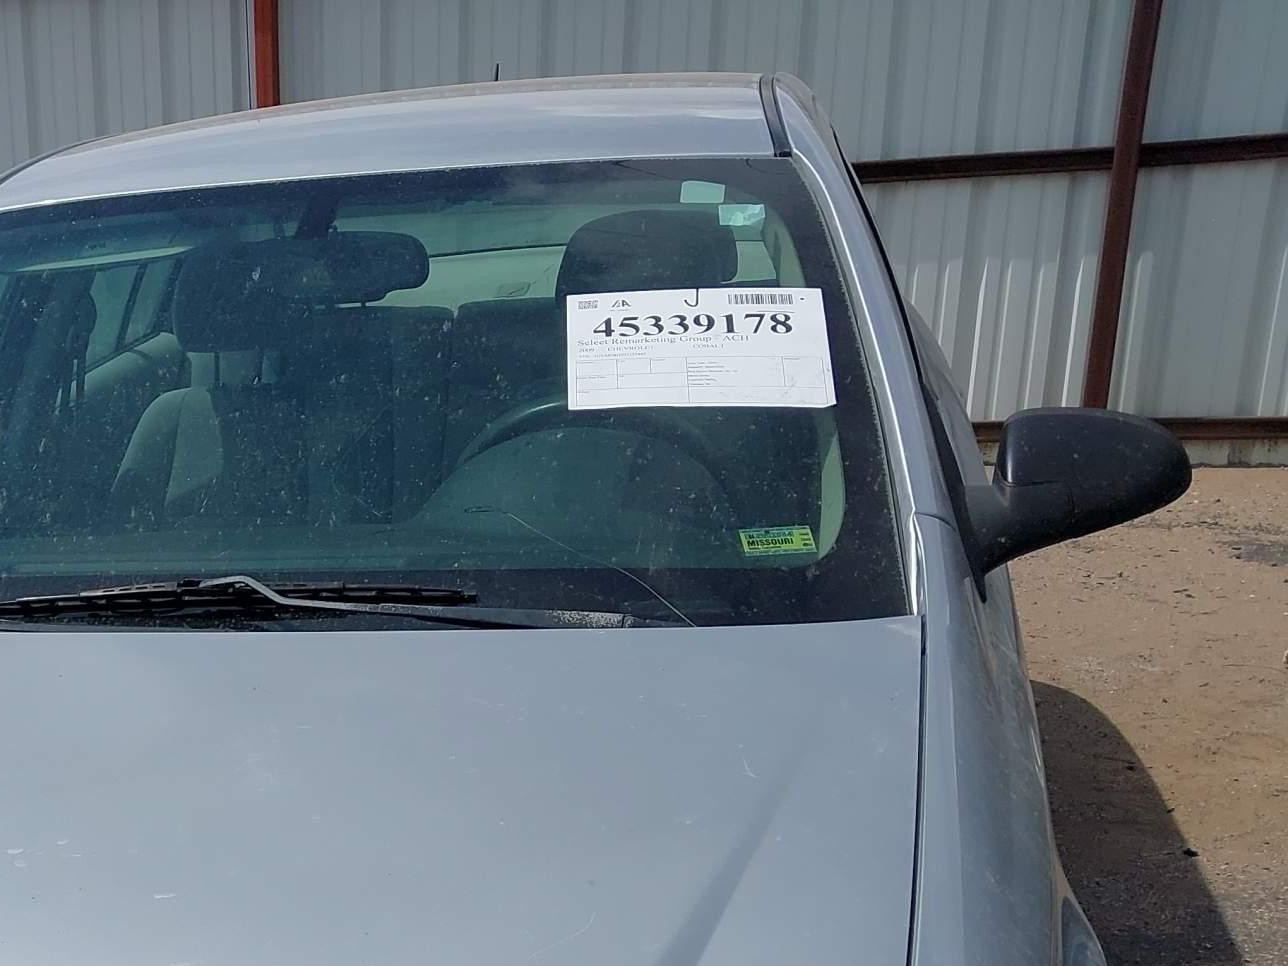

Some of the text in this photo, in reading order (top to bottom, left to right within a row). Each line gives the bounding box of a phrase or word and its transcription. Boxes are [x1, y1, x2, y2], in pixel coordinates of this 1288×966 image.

[593, 313, 794, 337] 45339178
[577, 337, 609, 346] Select
[611, 336, 677, 345] Remarketing
[747, 538, 794, 547] MISSOURI
